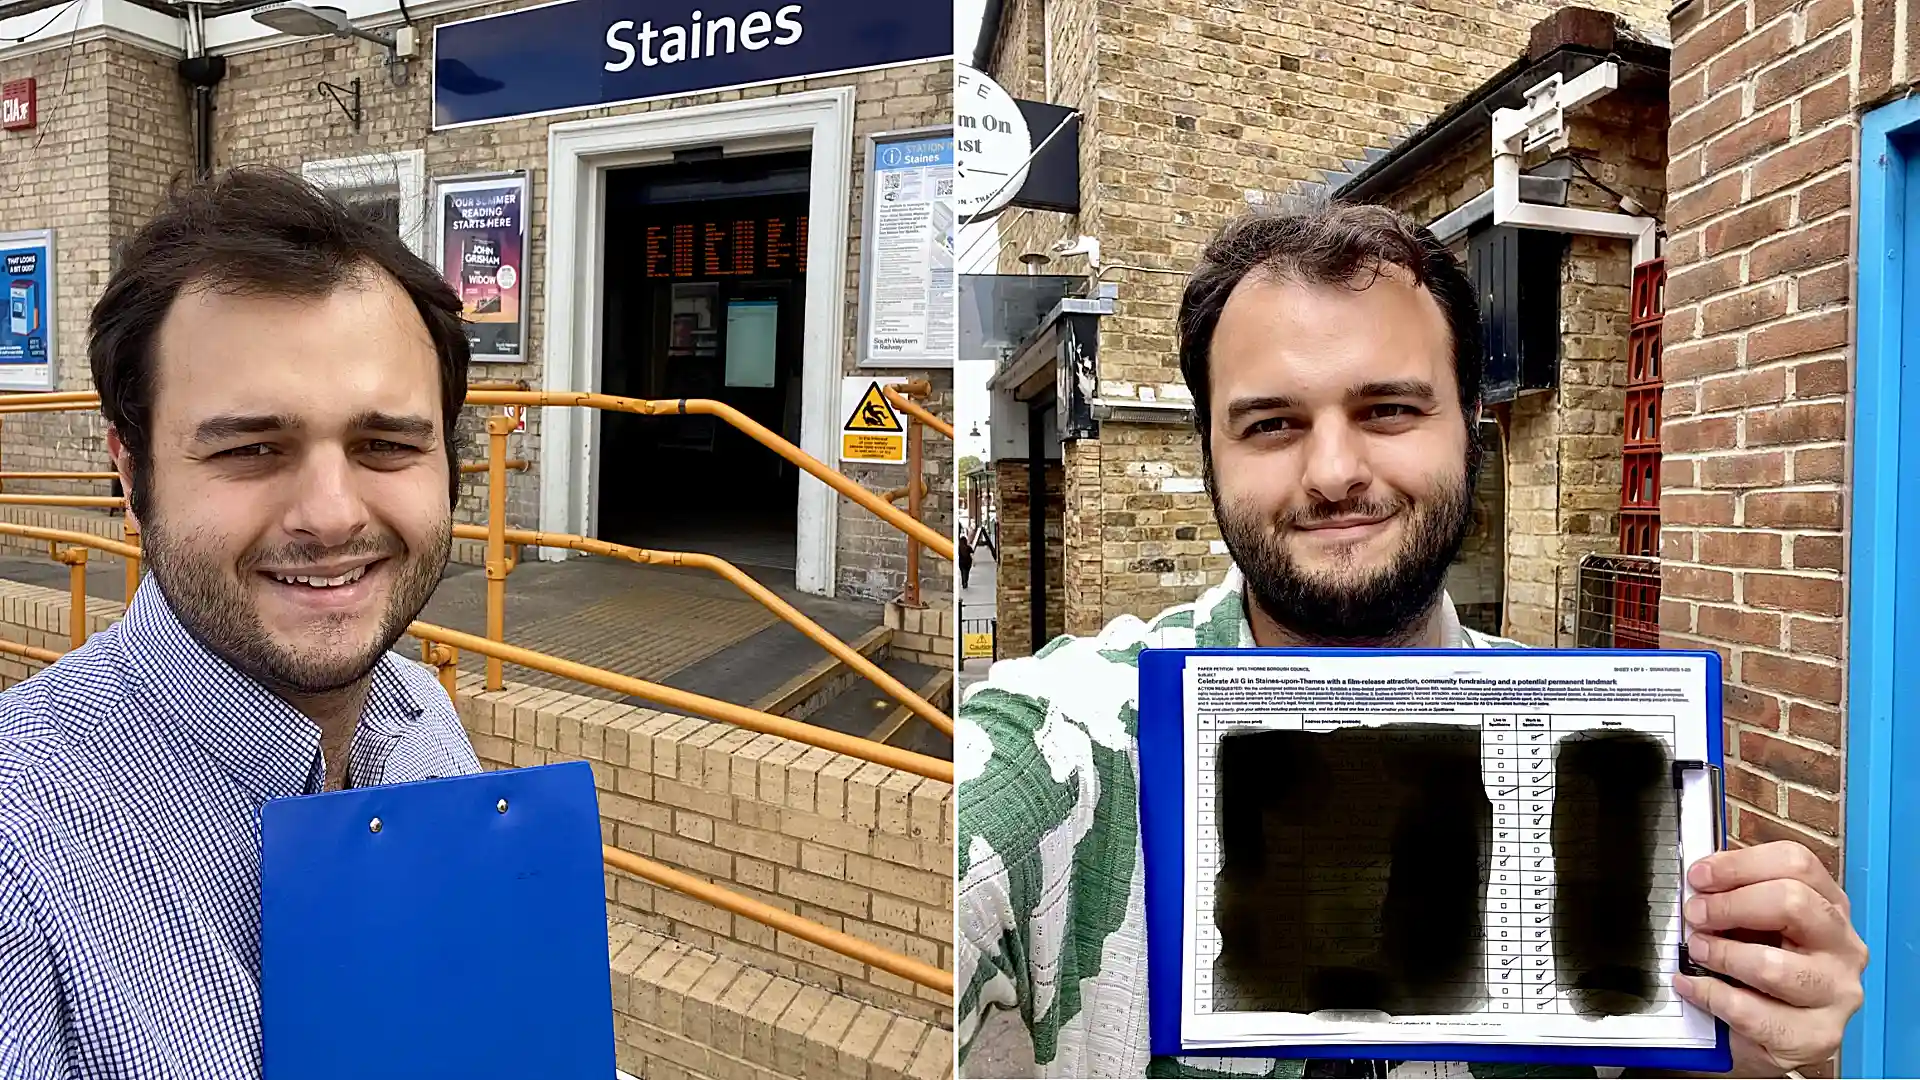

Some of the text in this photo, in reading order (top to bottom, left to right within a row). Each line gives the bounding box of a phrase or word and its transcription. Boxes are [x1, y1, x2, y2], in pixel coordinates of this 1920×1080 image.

[604, 4, 803, 72] Staines
[982, 114, 1012, 134] On
[958, 139, 982, 153] st
[903, 153, 940, 165] Staines
[462, 207, 503, 217] READING
[453, 217, 512, 229] STARTS HERE
[473, 245, 494, 255] JOHN
[465, 254, 500, 264] GRISHAM
[469, 276, 497, 284] WIDOW
[873, 337, 918, 345] South Western
[879, 344, 902, 352] Railway
[1458, 678, 1496, 686] fundraising
[1517, 678, 1547, 686] potential
